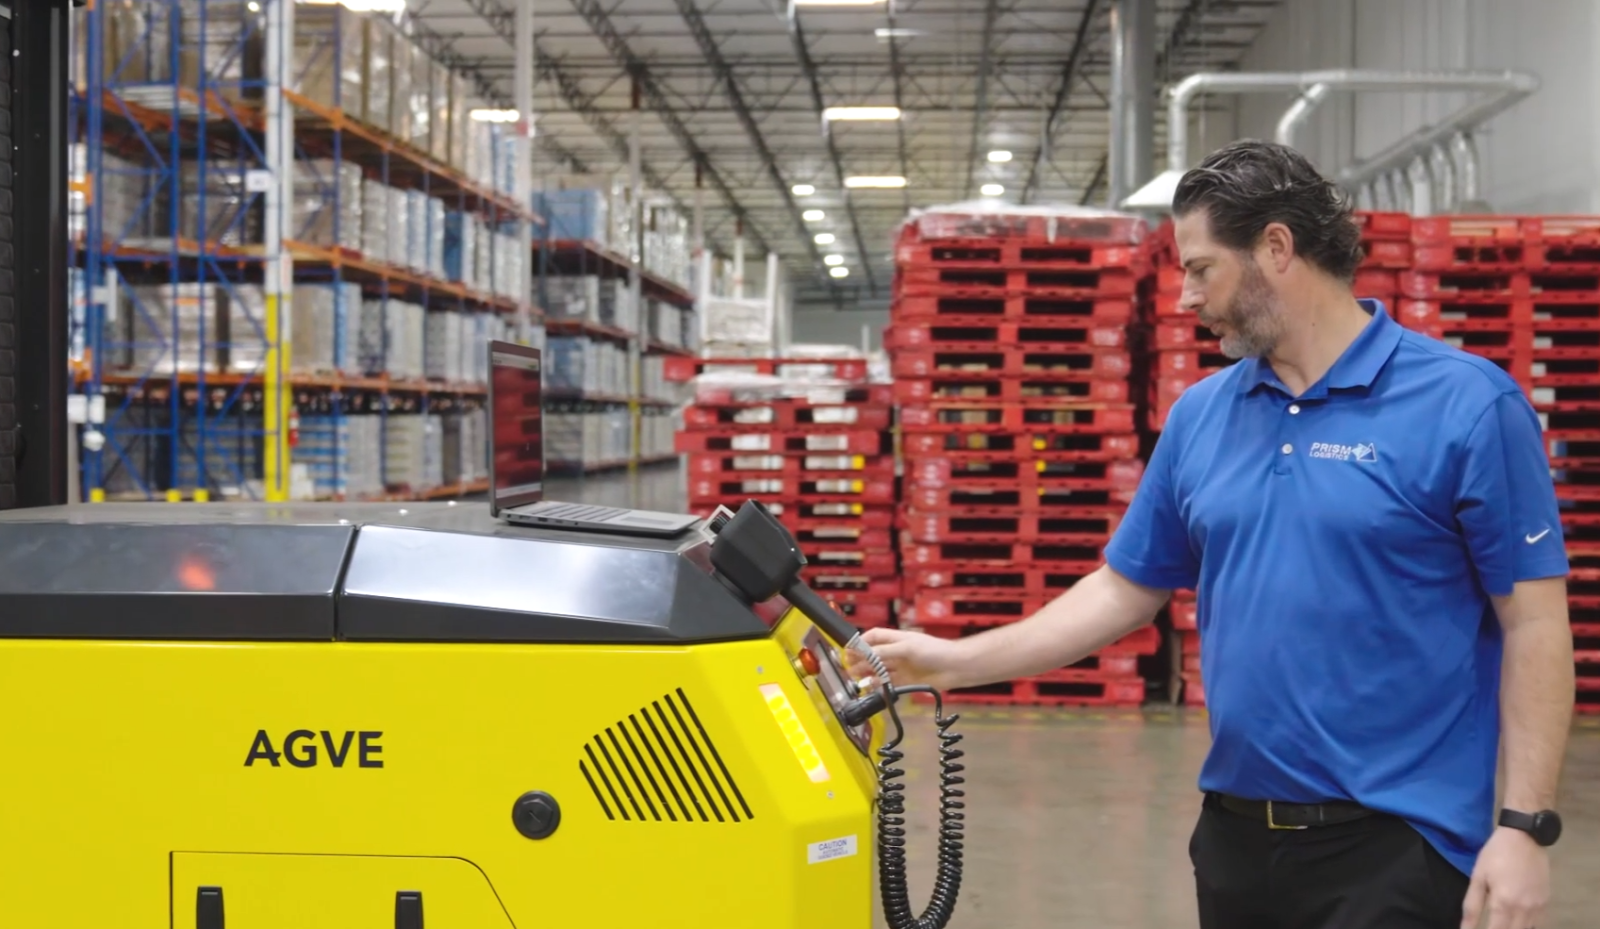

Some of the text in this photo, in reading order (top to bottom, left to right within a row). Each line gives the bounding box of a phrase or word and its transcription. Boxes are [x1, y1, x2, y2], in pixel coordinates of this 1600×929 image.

[1310, 442, 1352, 455] PRISM
[1309, 451, 1349, 460] LOGISTICS
[244, 729, 384, 768] AGVE
[818, 839, 848, 851] CAUTION
